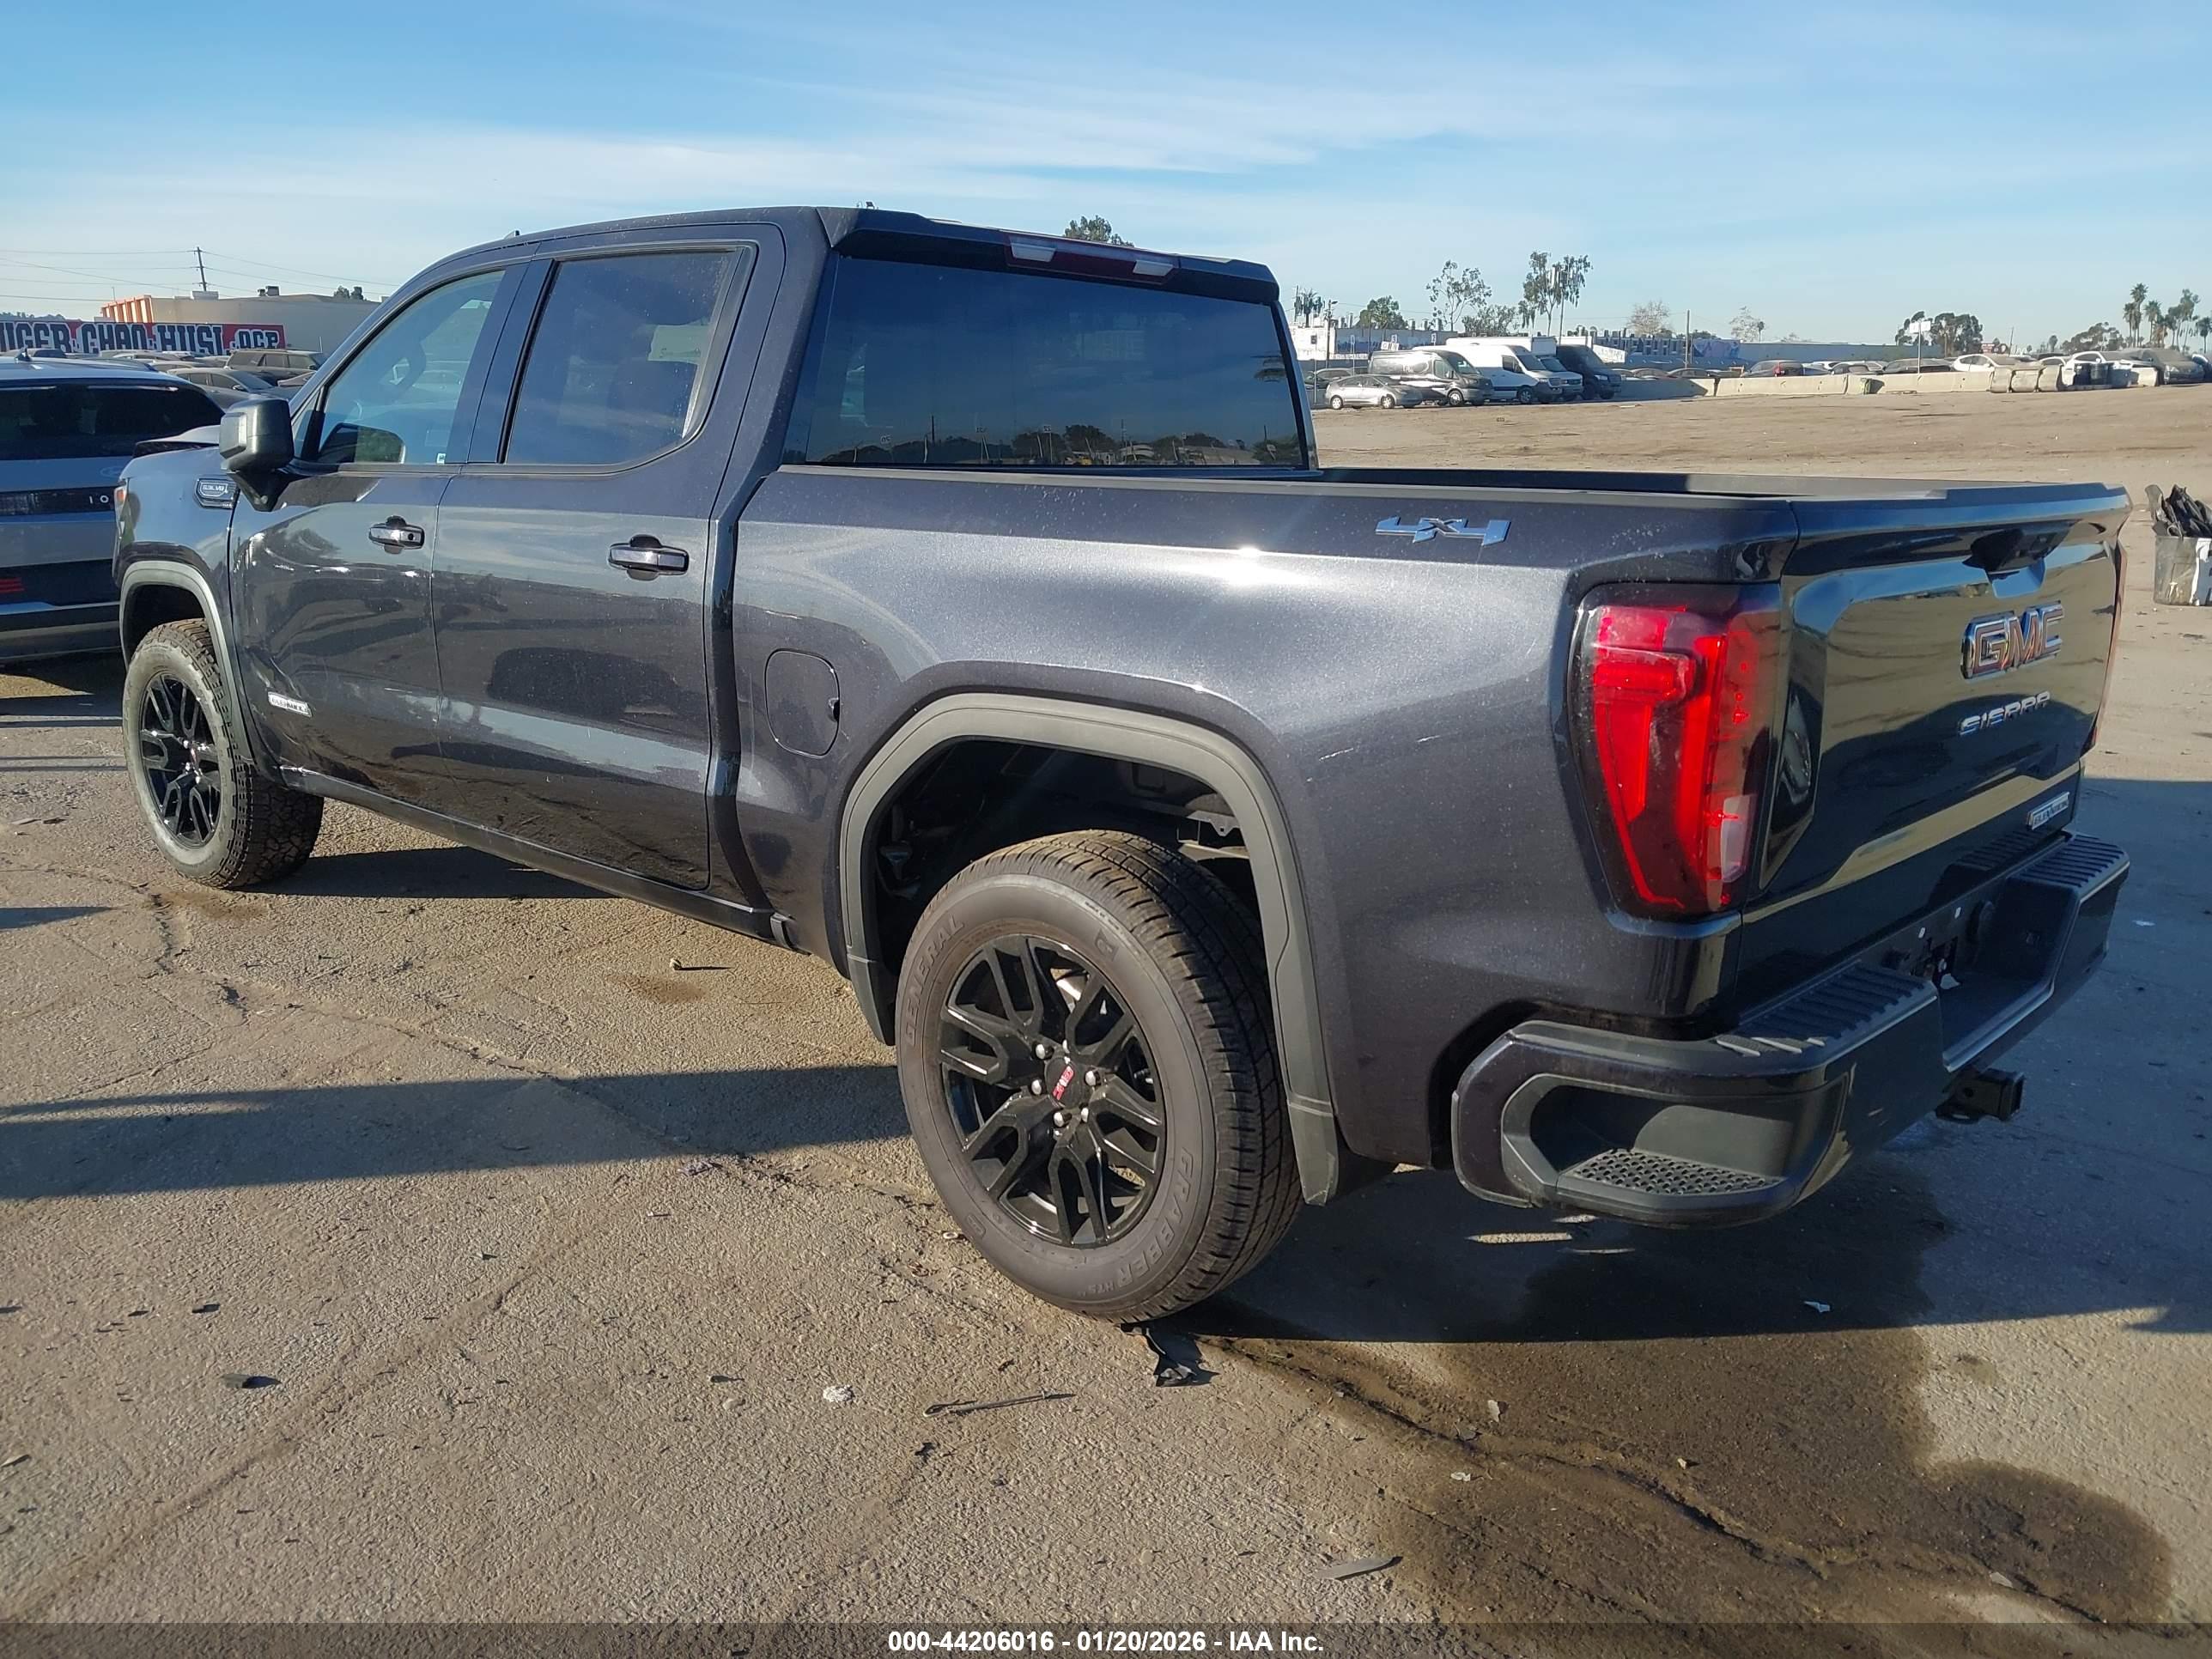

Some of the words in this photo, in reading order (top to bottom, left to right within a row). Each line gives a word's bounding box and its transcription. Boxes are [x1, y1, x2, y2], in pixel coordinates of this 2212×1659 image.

[1961, 601, 2064, 678] GMC
[1960, 691, 2051, 735] SIERRA
[905, 914, 965, 1047] GENERAL
[1118, 1146, 1194, 1288] GRABBER
